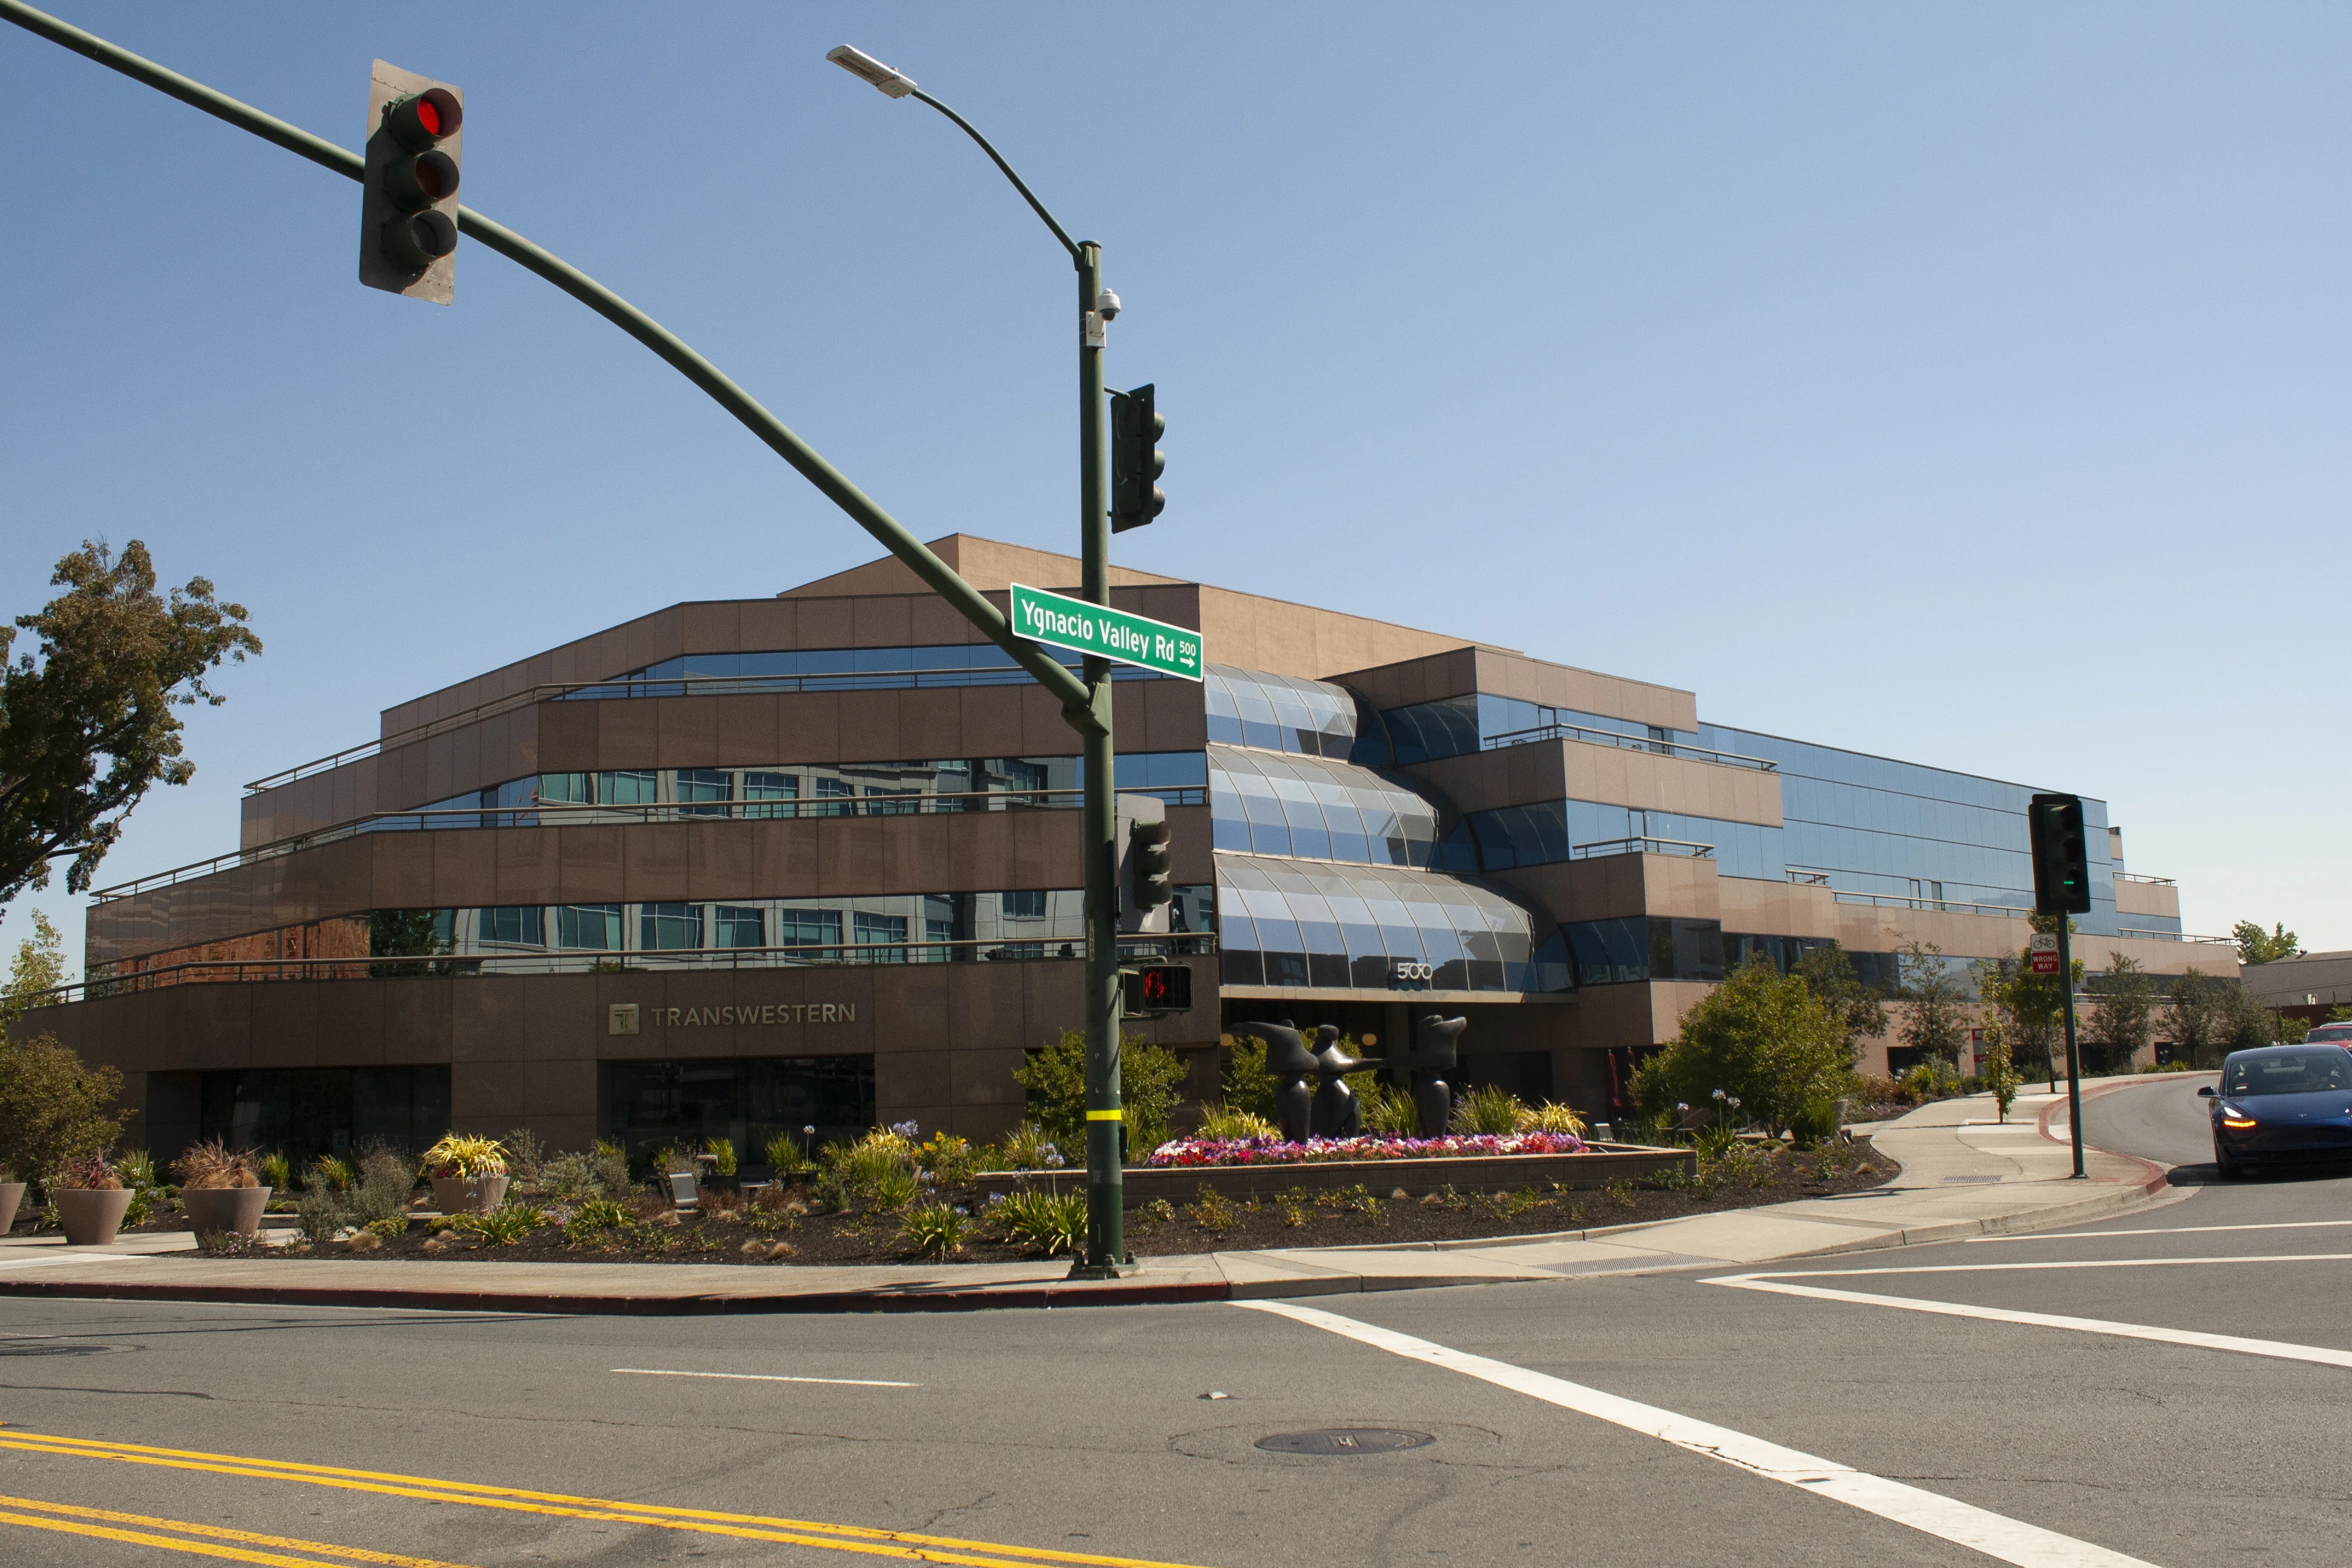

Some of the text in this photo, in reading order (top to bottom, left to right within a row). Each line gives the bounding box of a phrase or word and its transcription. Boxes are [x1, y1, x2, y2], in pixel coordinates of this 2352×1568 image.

[1021, 598, 1175, 662] Ygnacio Valley Rd
[1180, 641, 1197, 657] 500
[1397, 962, 1433, 979] 500
[651, 1003, 856, 1027] TRANSWESTERN
